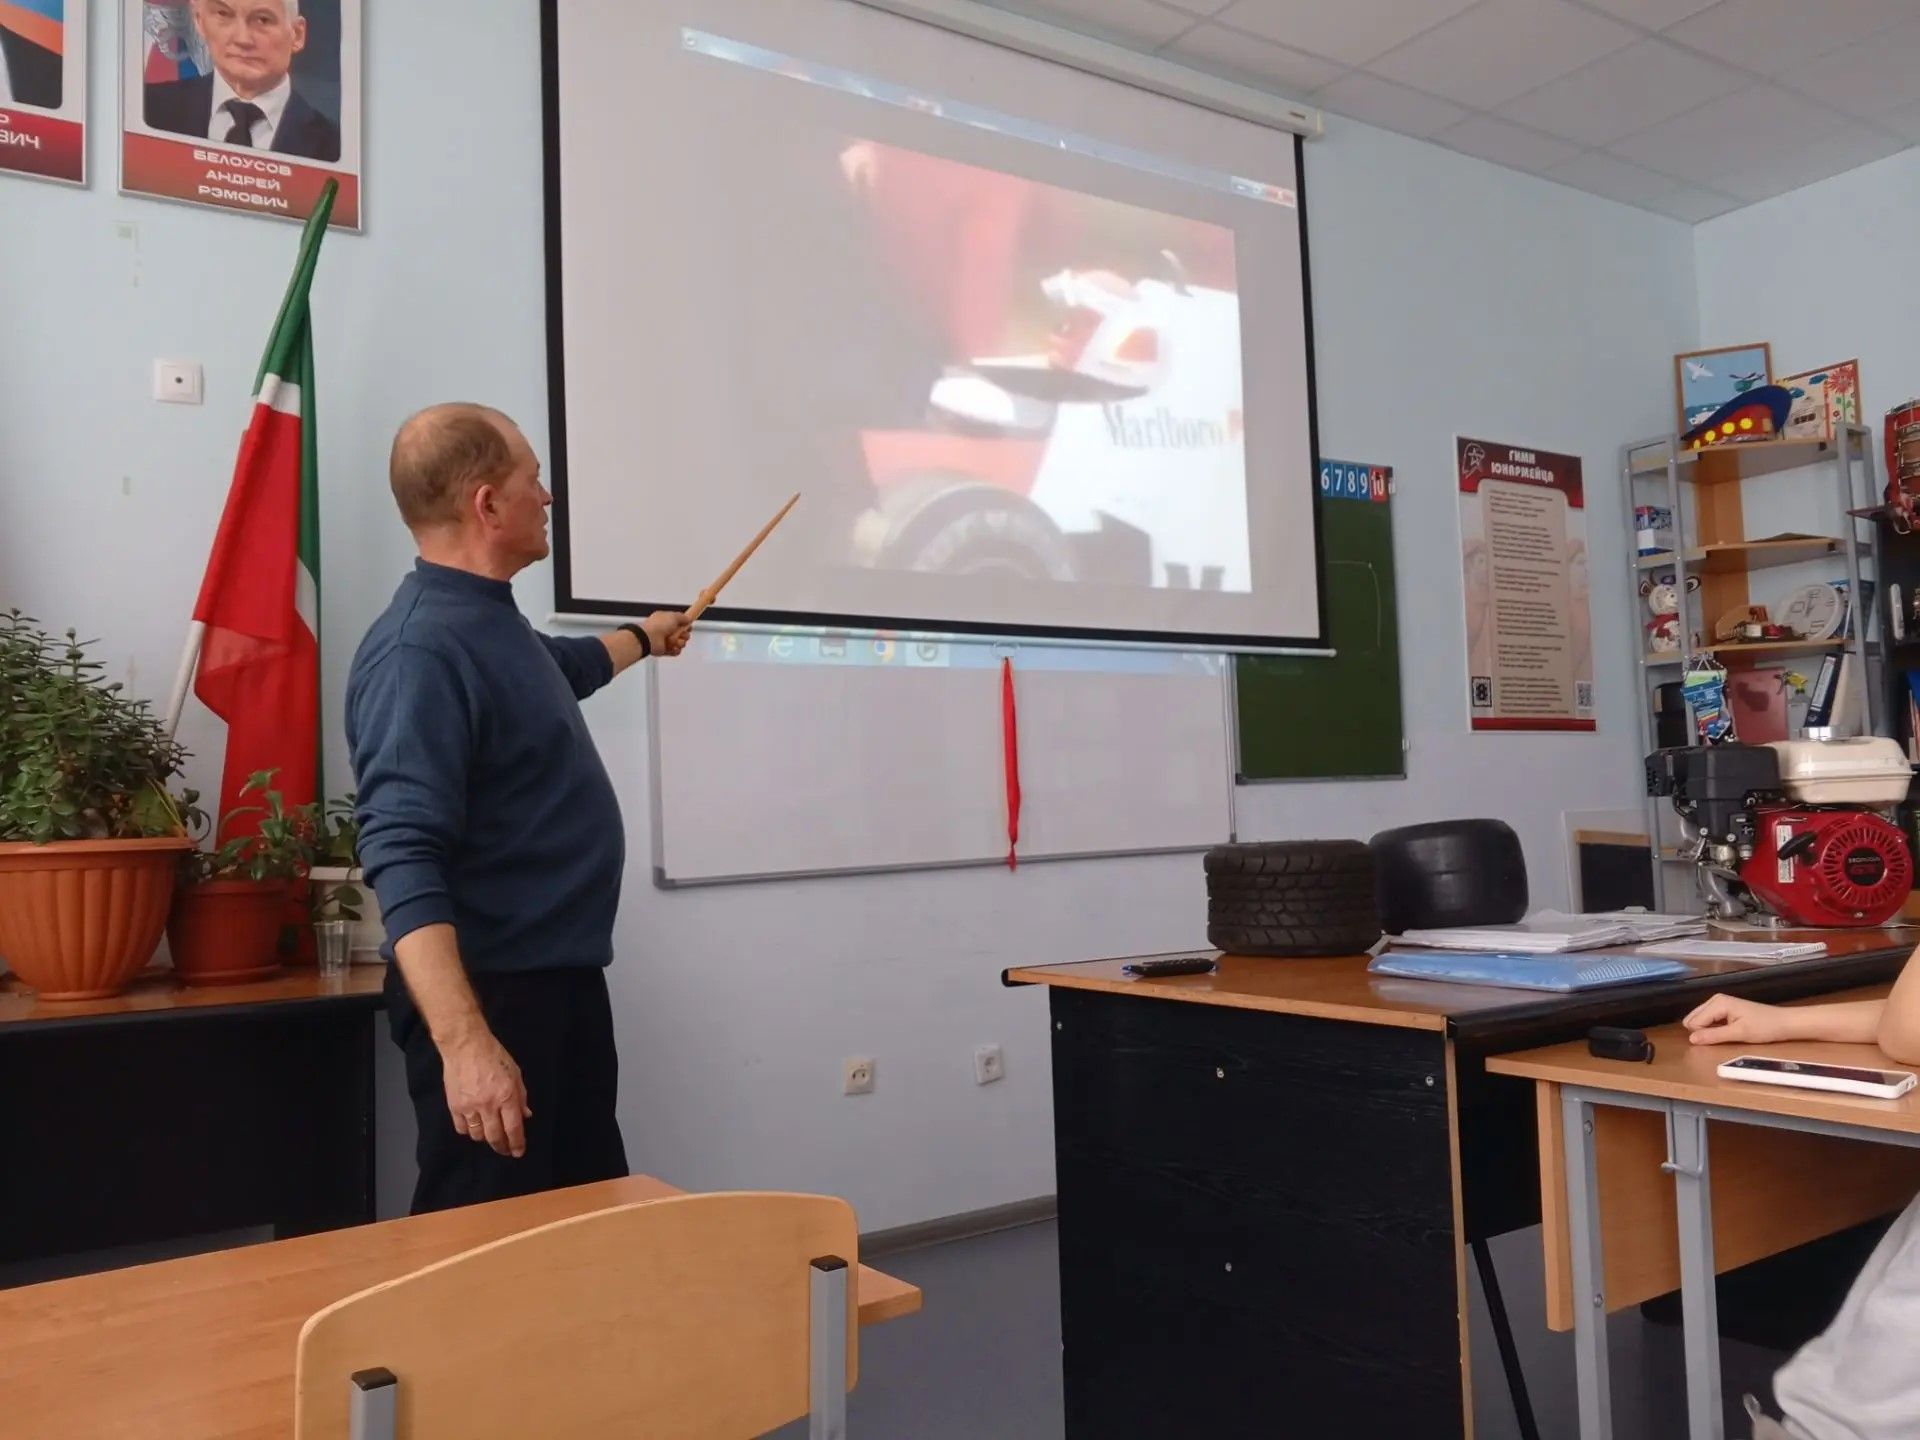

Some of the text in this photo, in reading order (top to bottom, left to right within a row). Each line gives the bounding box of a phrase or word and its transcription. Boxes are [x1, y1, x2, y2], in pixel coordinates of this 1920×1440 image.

[193, 149, 292, 176] БЕЛОУСОВ
[206, 169, 281, 192] АНДРЕЙ
[198, 185, 288, 209] РЭМОВИЧ
[1101, 402, 1224, 449] Marlboro
[1508, 449, 1536, 464] ГИМН
[1320, 467, 1331, 491] 6
[1334, 468, 1343, 491] 7
[1347, 470, 1356, 493] 8
[1360, 472, 1368, 494] 9
[1490, 462, 1554, 483] ЮНАРМЕЙЦА
